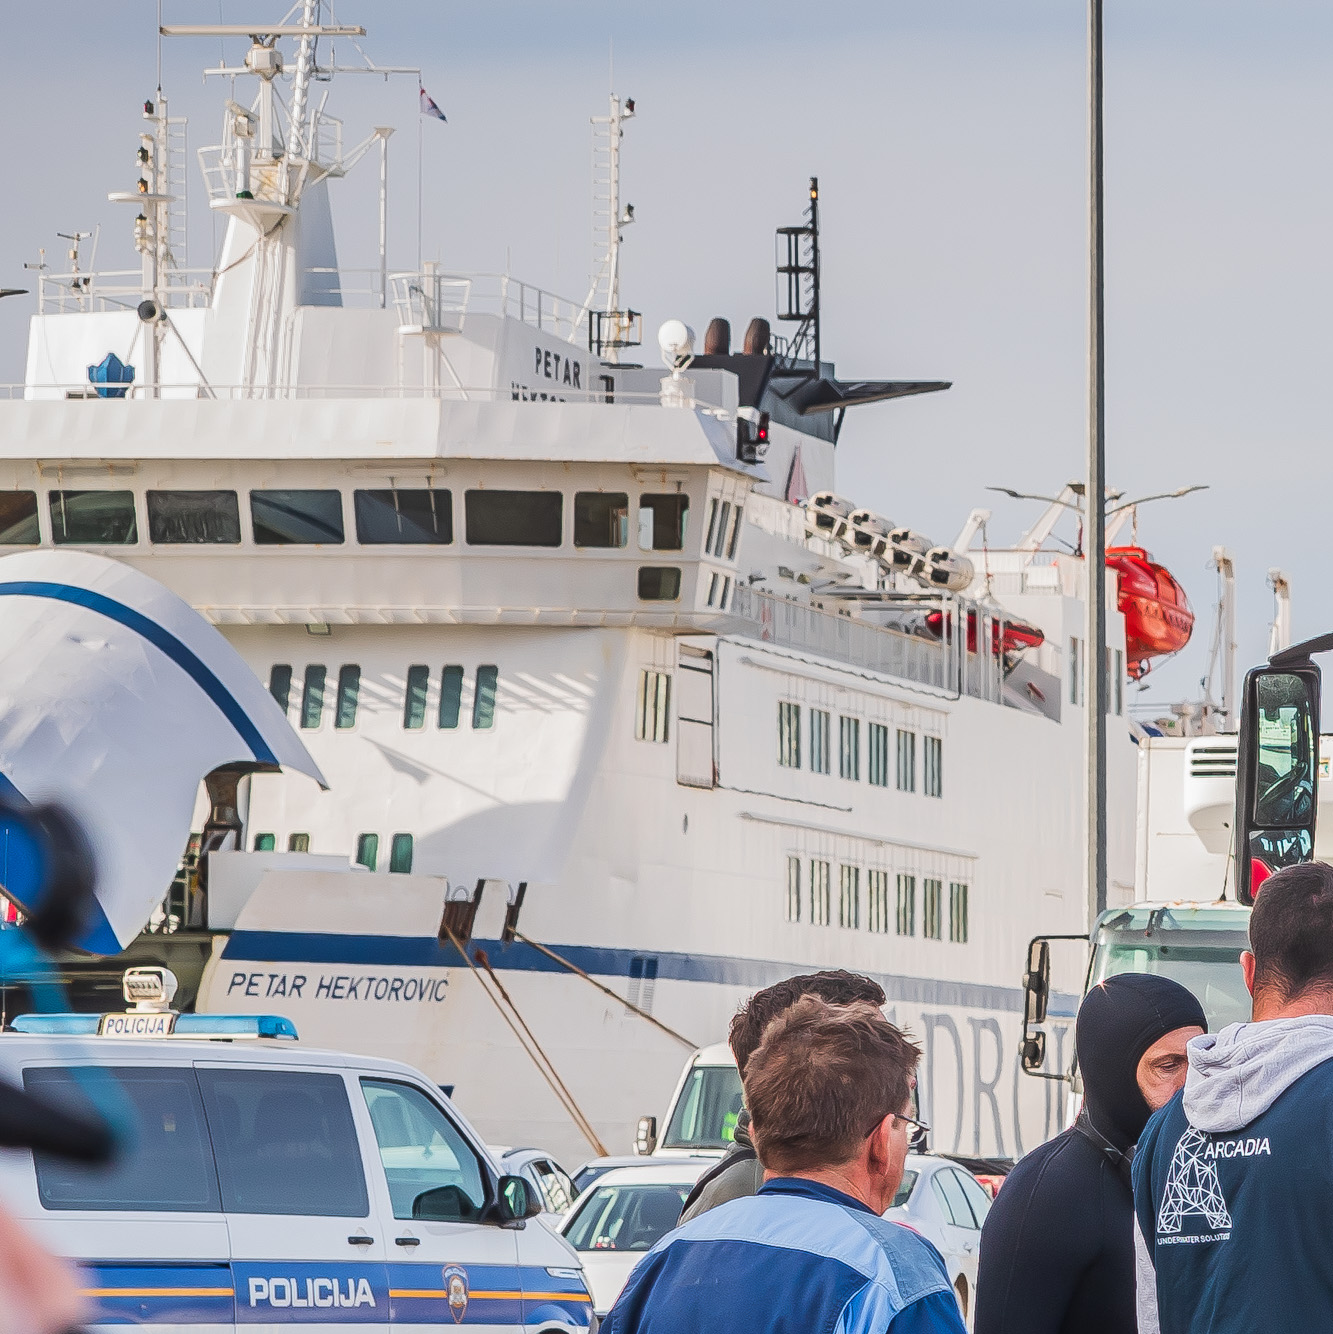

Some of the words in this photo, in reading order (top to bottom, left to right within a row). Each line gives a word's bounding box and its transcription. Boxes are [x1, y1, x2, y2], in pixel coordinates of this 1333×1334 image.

[535, 346, 581, 390] PETAR
[227, 972, 307, 998] PETAR
[106, 1018, 164, 1034] POLICIJA
[1203, 1137, 1271, 1160] ARCADIA
[248, 1277, 376, 1308] POLICIJA
